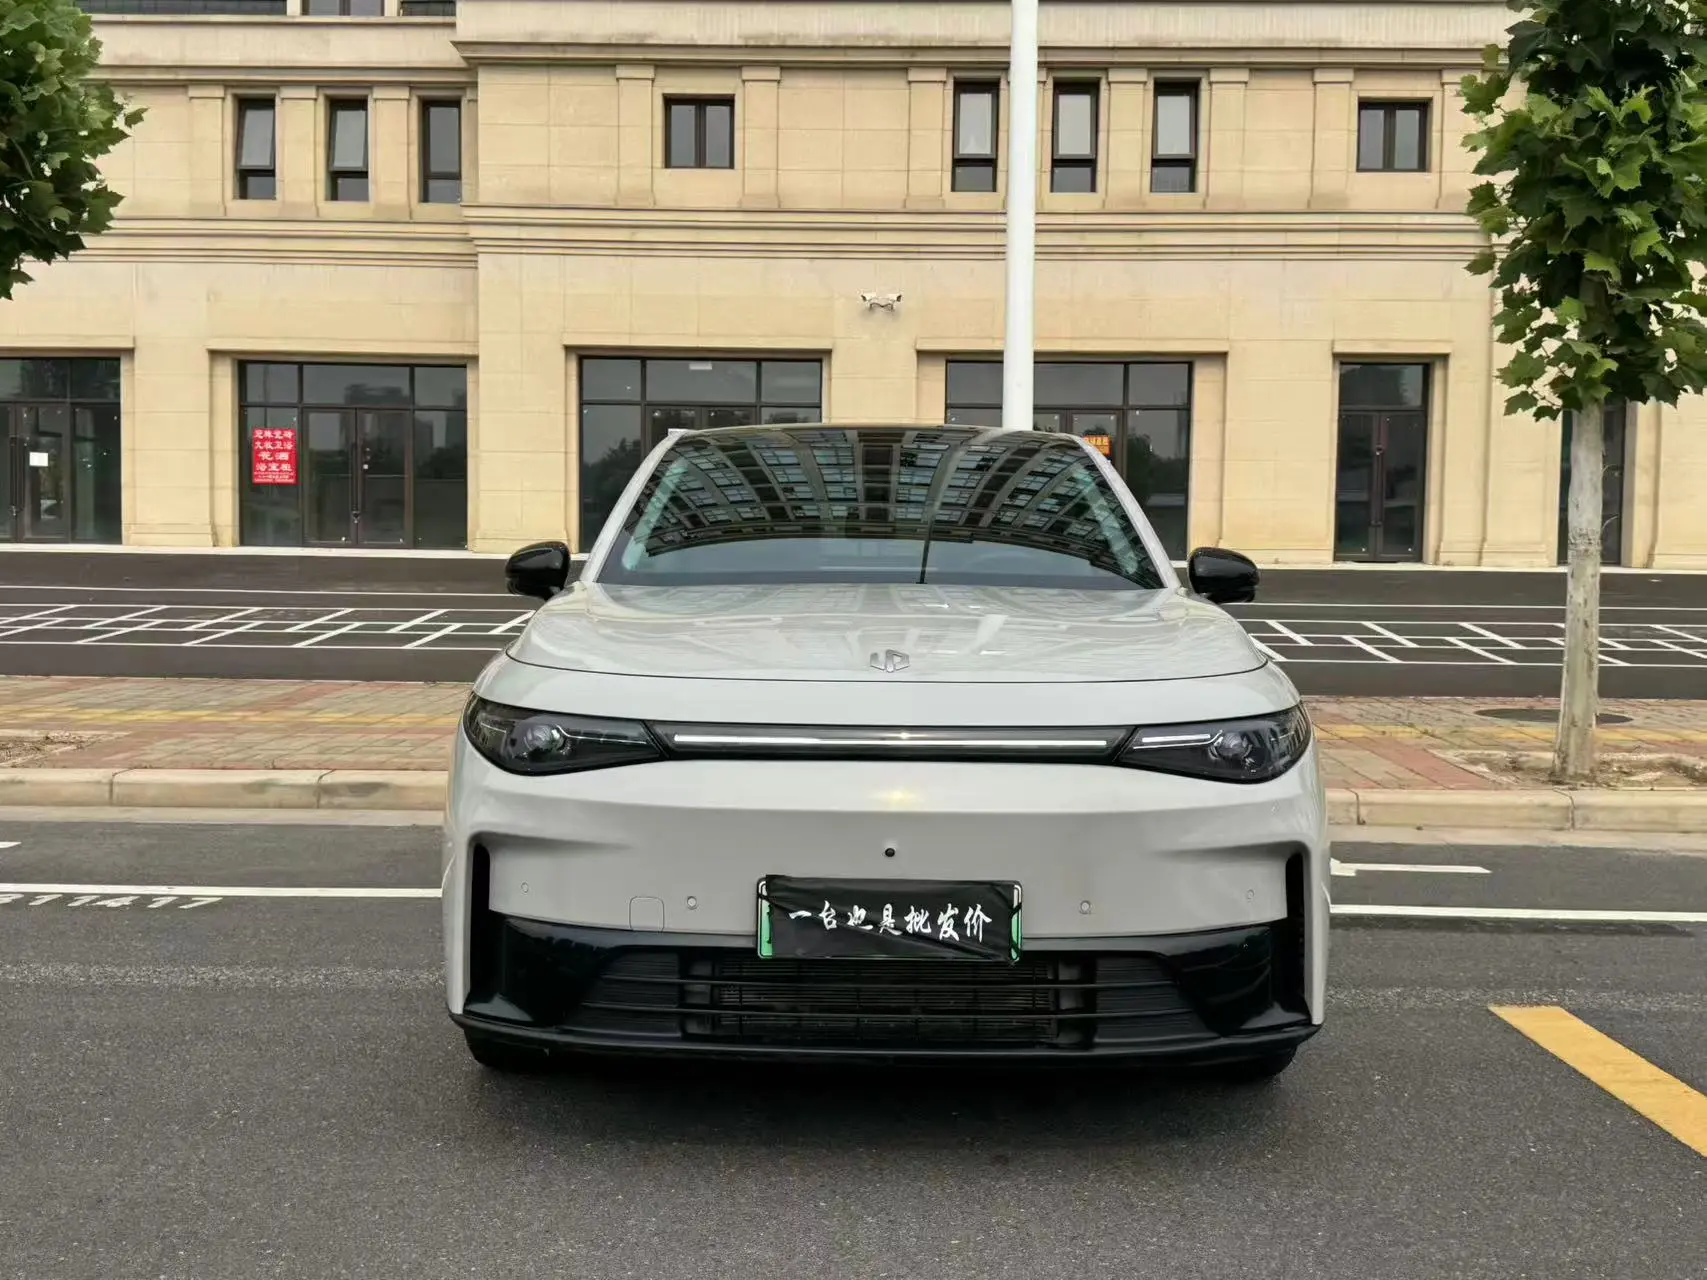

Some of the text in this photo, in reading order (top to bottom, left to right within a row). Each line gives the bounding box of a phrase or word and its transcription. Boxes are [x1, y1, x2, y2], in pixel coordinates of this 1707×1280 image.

[788, 900, 993, 943] 一台也是批发价
